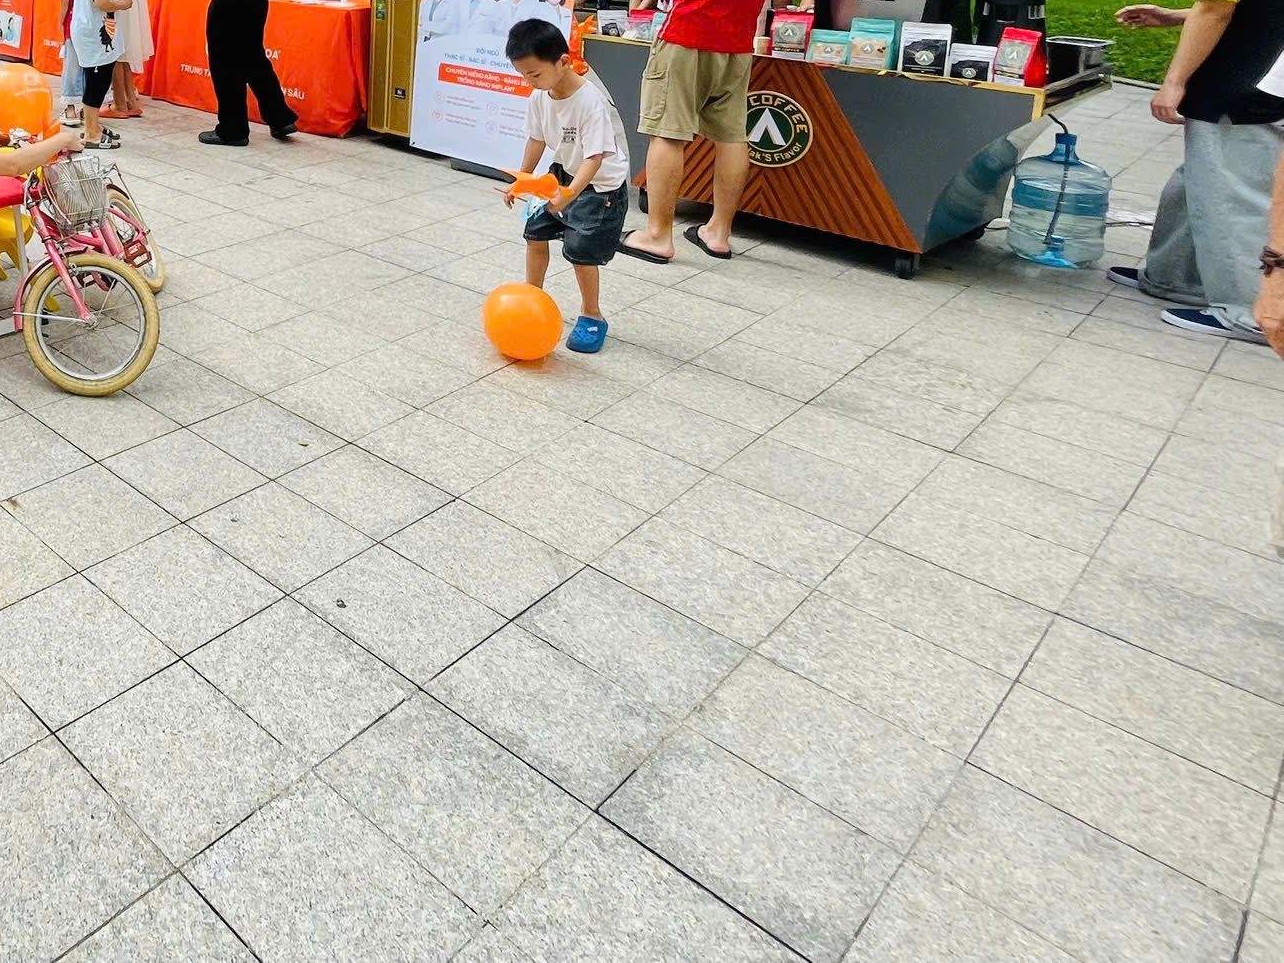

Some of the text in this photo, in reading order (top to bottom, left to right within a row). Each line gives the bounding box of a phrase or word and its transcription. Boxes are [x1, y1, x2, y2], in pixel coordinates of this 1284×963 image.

[180, 63, 203, 76] TRUNG
[287, 88, 305, 100] SÂU
[749, 95, 808, 133] COFFEE
